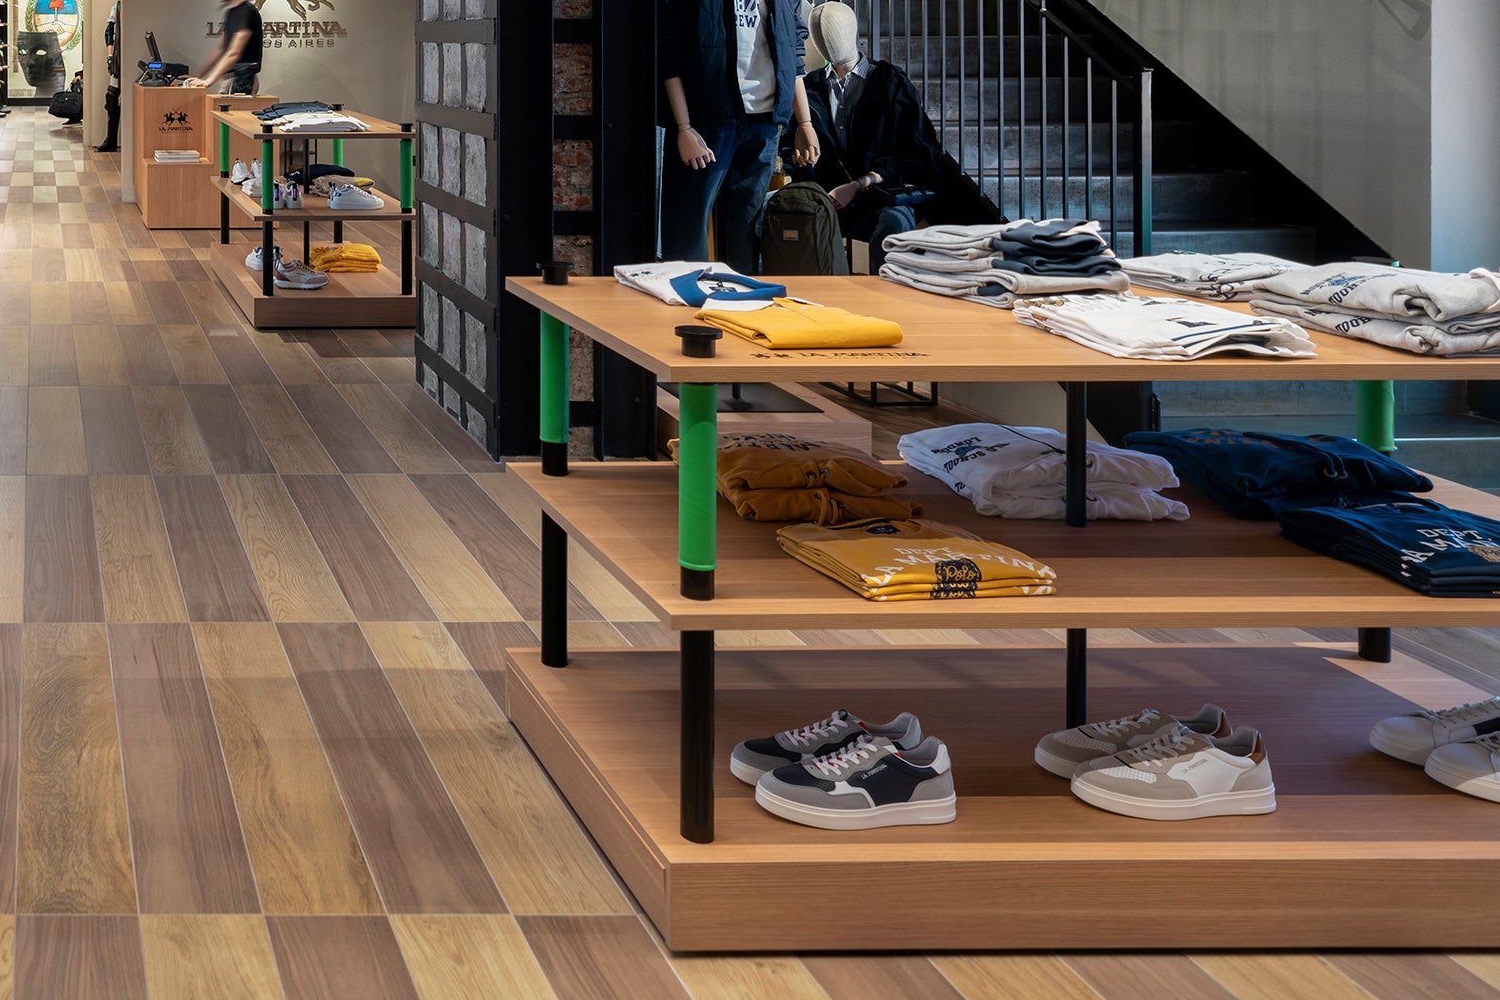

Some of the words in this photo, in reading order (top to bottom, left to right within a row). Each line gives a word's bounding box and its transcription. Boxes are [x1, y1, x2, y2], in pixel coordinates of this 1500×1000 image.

[263, 21, 348, 38] ARTINA
[288, 39, 335, 48] AIRES
[943, 565, 976, 582] Polo
